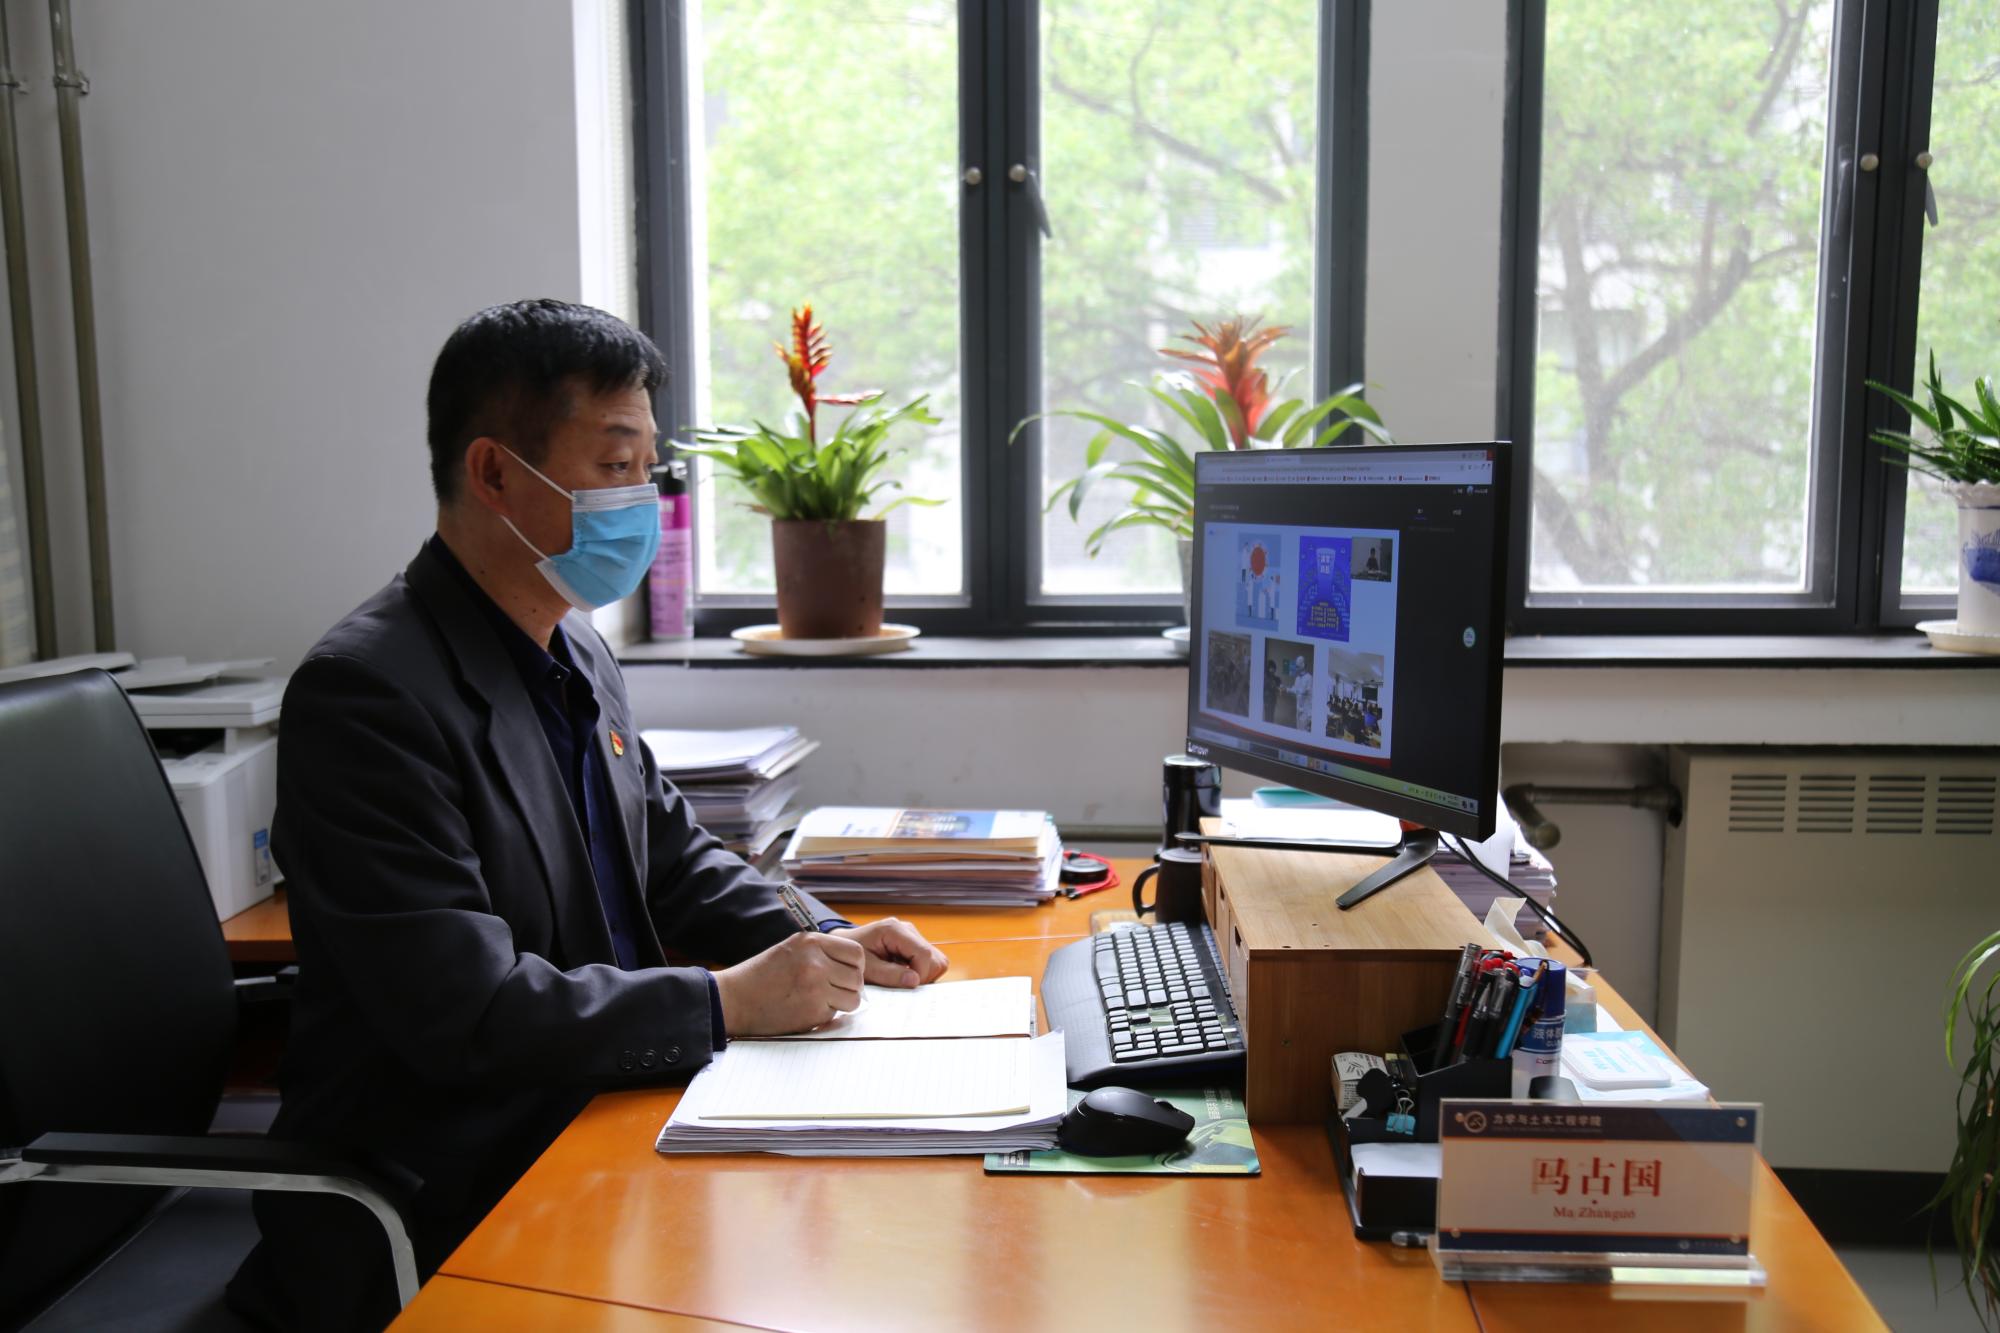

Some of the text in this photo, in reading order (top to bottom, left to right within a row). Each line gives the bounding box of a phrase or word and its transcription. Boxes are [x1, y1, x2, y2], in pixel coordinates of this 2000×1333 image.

[1492, 1112, 1602, 1127] 力学与土木工程学院
[1553, 1206, 1574, 1218] Ma
